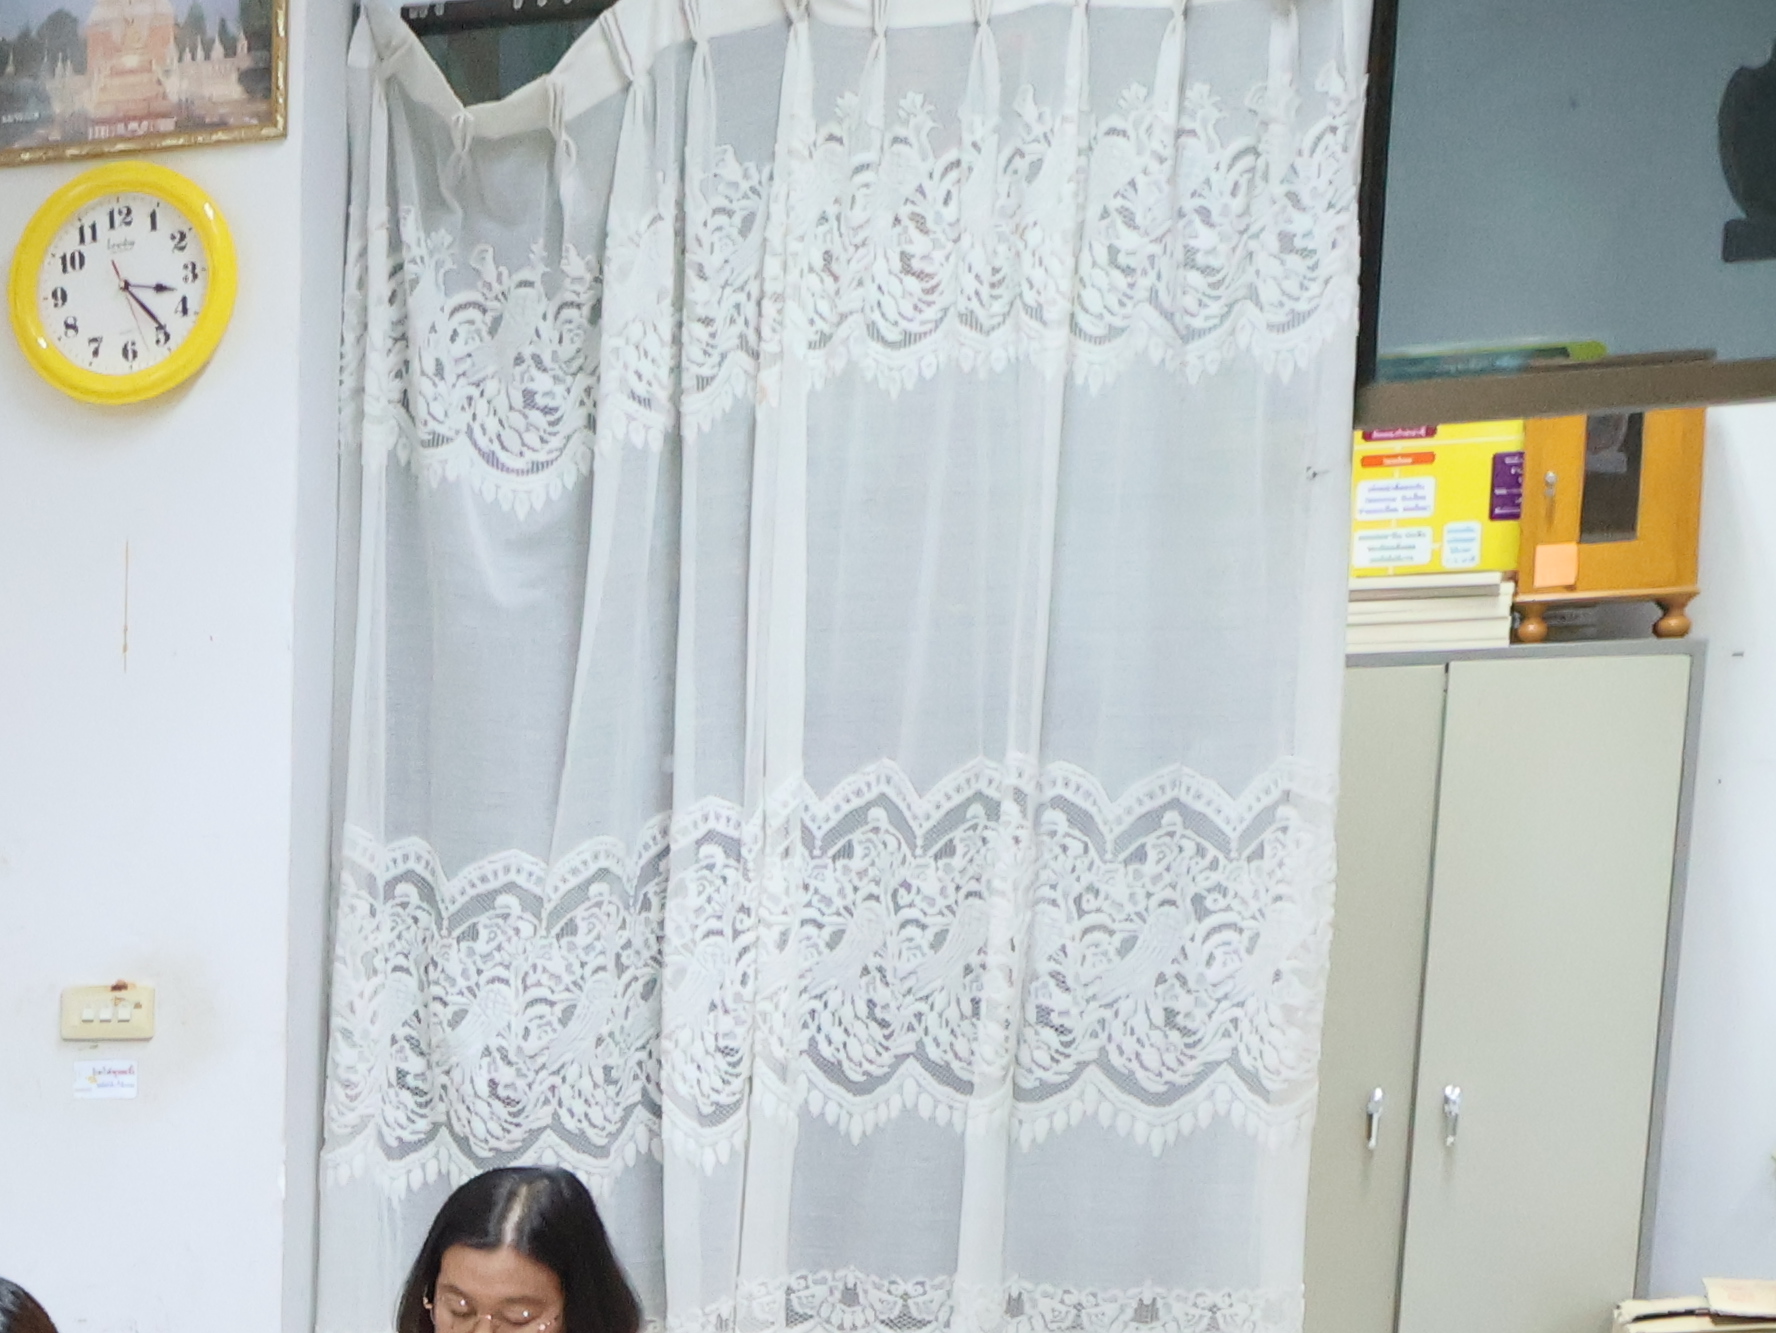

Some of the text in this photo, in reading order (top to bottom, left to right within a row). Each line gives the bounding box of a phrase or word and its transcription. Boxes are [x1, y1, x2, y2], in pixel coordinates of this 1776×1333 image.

[107, 205, 133, 231] 12
[149, 207, 158, 232] 1
[77, 222, 98, 246] 11
[170, 230, 188, 253] 2
[59, 250, 85, 274] 10
[182, 261, 199, 284] 3
[51, 286, 68, 309] 9
[174, 295, 189, 318] 4
[64, 316, 79, 338] 8
[155, 325, 171, 347] 5
[88, 336, 103, 359] 7
[122, 340, 138, 363] 6
